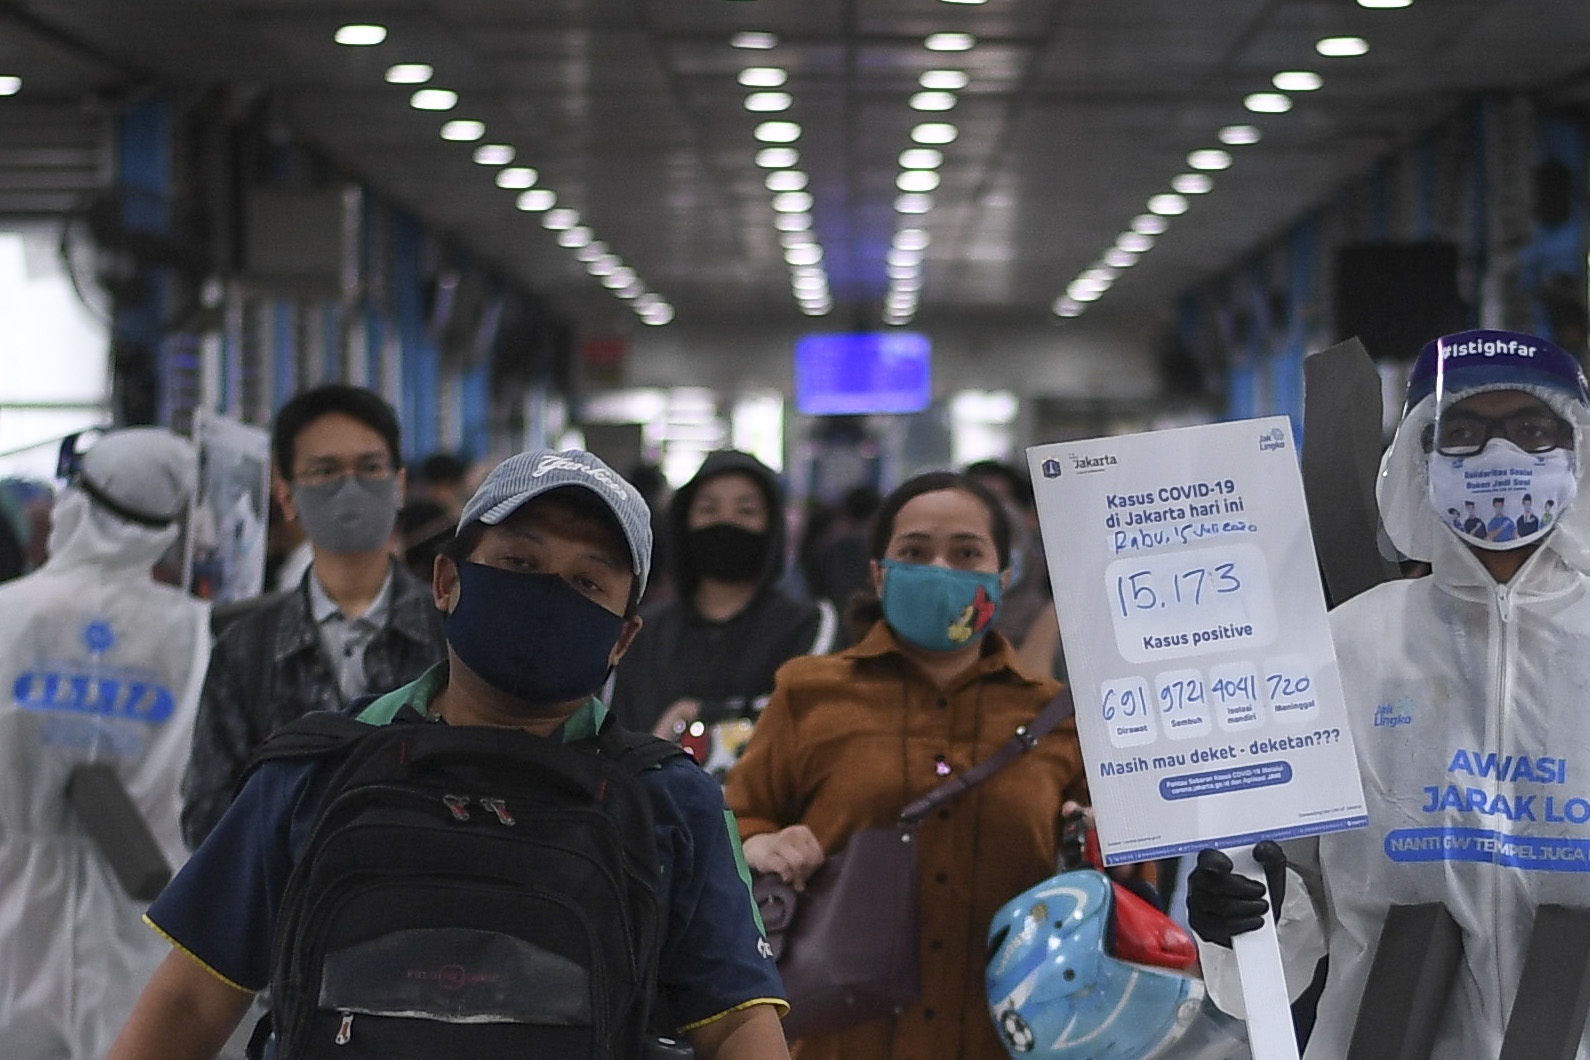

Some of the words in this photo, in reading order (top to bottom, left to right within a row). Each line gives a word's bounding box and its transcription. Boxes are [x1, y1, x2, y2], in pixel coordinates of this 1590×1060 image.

[1074, 454, 1118, 469] Jakarta
[1106, 492, 1155, 509] Kasus
[1158, 479, 1236, 502] COVID-19
[1106, 513, 1121, 528] di
[1125, 507, 1186, 526] Jakarta
[1189, 500, 1220, 518] hari
[1223, 496, 1244, 513] ini
[1174, 524, 1192, 544] 15
[1118, 563, 1241, 617] 15.173
[1143, 633, 1189, 650] Kasus
[1192, 623, 1253, 647] positive
[1211, 675, 1257, 702] 4041
[1266, 674, 1311, 701] 720
[1102, 686, 1148, 721] 691
[1227, 704, 1253, 714] Isolasi
[1274, 699, 1316, 712] Meninggal
[1117, 725, 1148, 735] Dirawat
[1170, 716, 1203, 727] Sembuh
[1227, 713, 1257, 724] mandiri
[1100, 758, 1149, 777] Masih
[1152, 753, 1186, 770] mau
[1190, 746, 1237, 764] deket
[1249, 728, 1341, 755] deketan???
[1448, 749, 1568, 784] AWASI
[1422, 785, 1536, 822] JARAK
[1390, 836, 1441, 852] NANTI
[1443, 835, 1471, 850] GW
[1475, 837, 1538, 859] TEMPEL
[1538, 846, 1585, 861] JUGA
